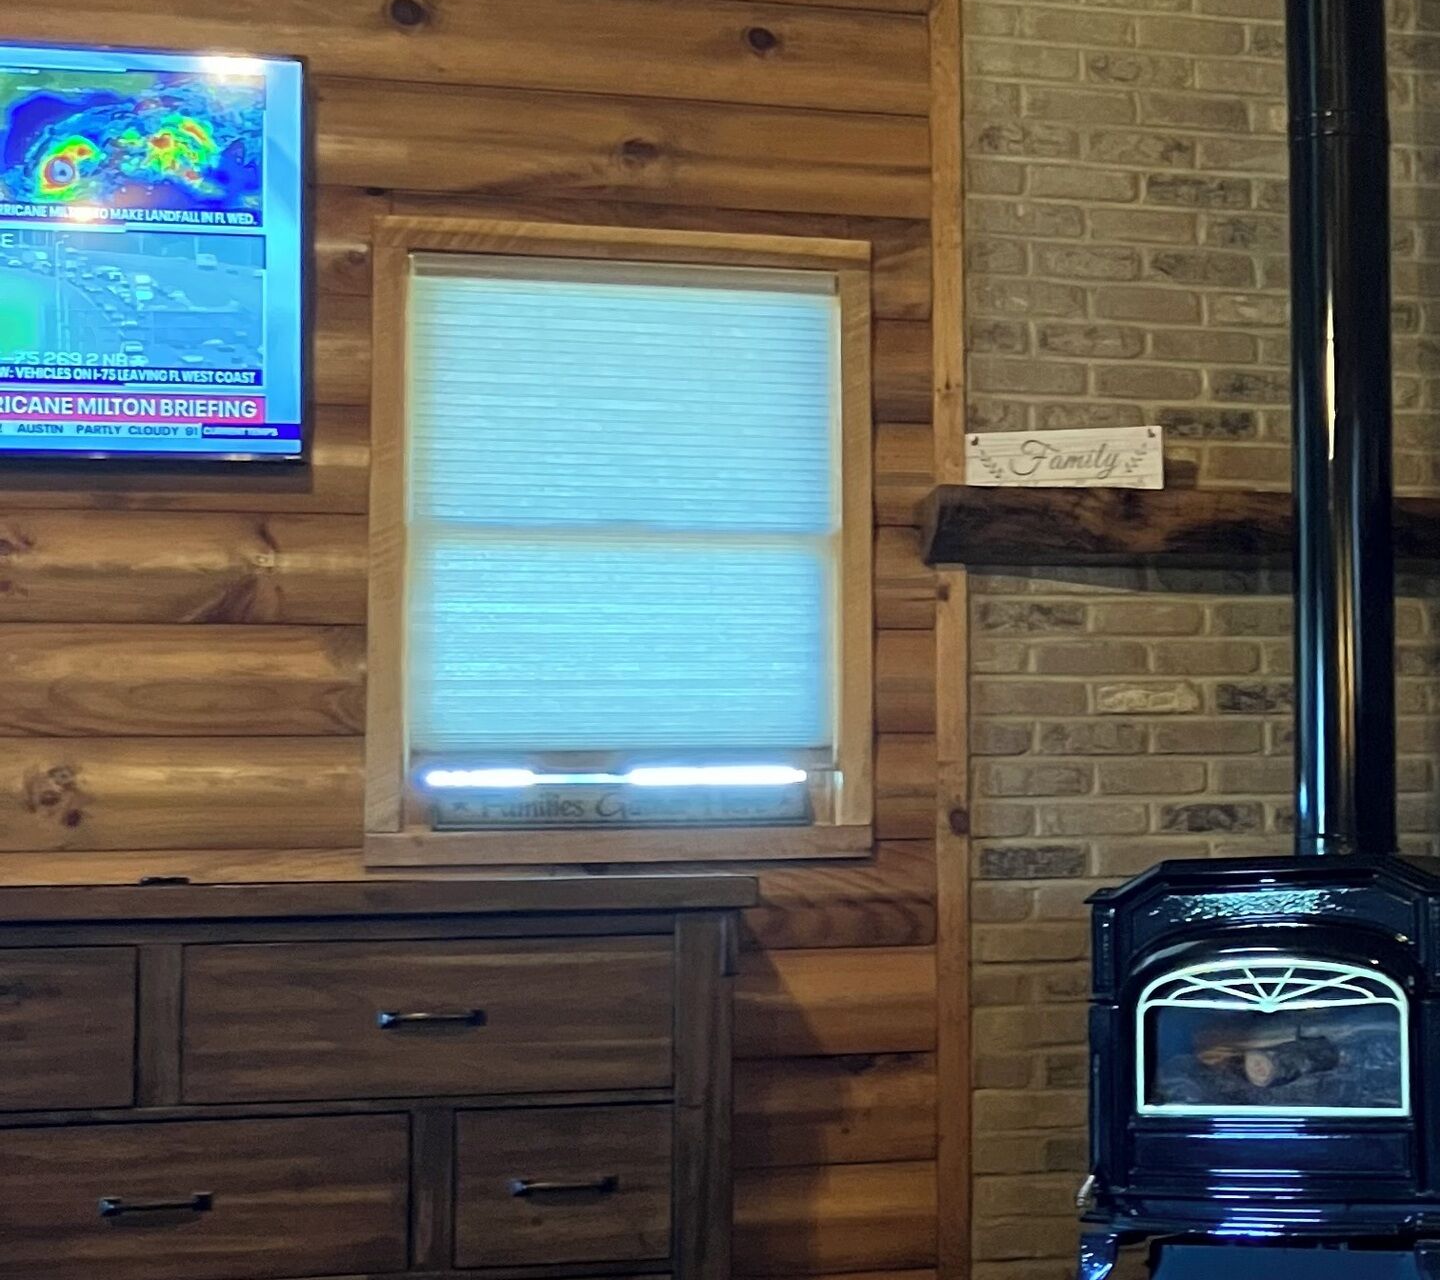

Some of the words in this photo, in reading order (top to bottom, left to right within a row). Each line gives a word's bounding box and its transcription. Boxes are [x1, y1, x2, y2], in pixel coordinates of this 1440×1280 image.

[110, 209, 144, 221] MAKE
[145, 209, 199, 223] LANDFALL
[201, 211, 213, 223] IN
[227, 212, 257, 225] WED.
[103, 353, 127, 367] NB
[15, 366, 71, 380] VEHICLES
[73, 368, 92, 380] ON
[93, 369, 116, 381] I-75
[117, 369, 167, 382] LEAVING
[182, 371, 213, 383] WEST
[214, 371, 256, 384] COAST
[77, 397, 156, 416] MILTON
[160, 398, 257, 418] BRIEFING
[17, 423, 63, 435] AUSTIN
[76, 424, 122, 435] PARTLY
[128, 425, 179, 437] CLOUDY
[1009, 439, 1121, 480] Family
